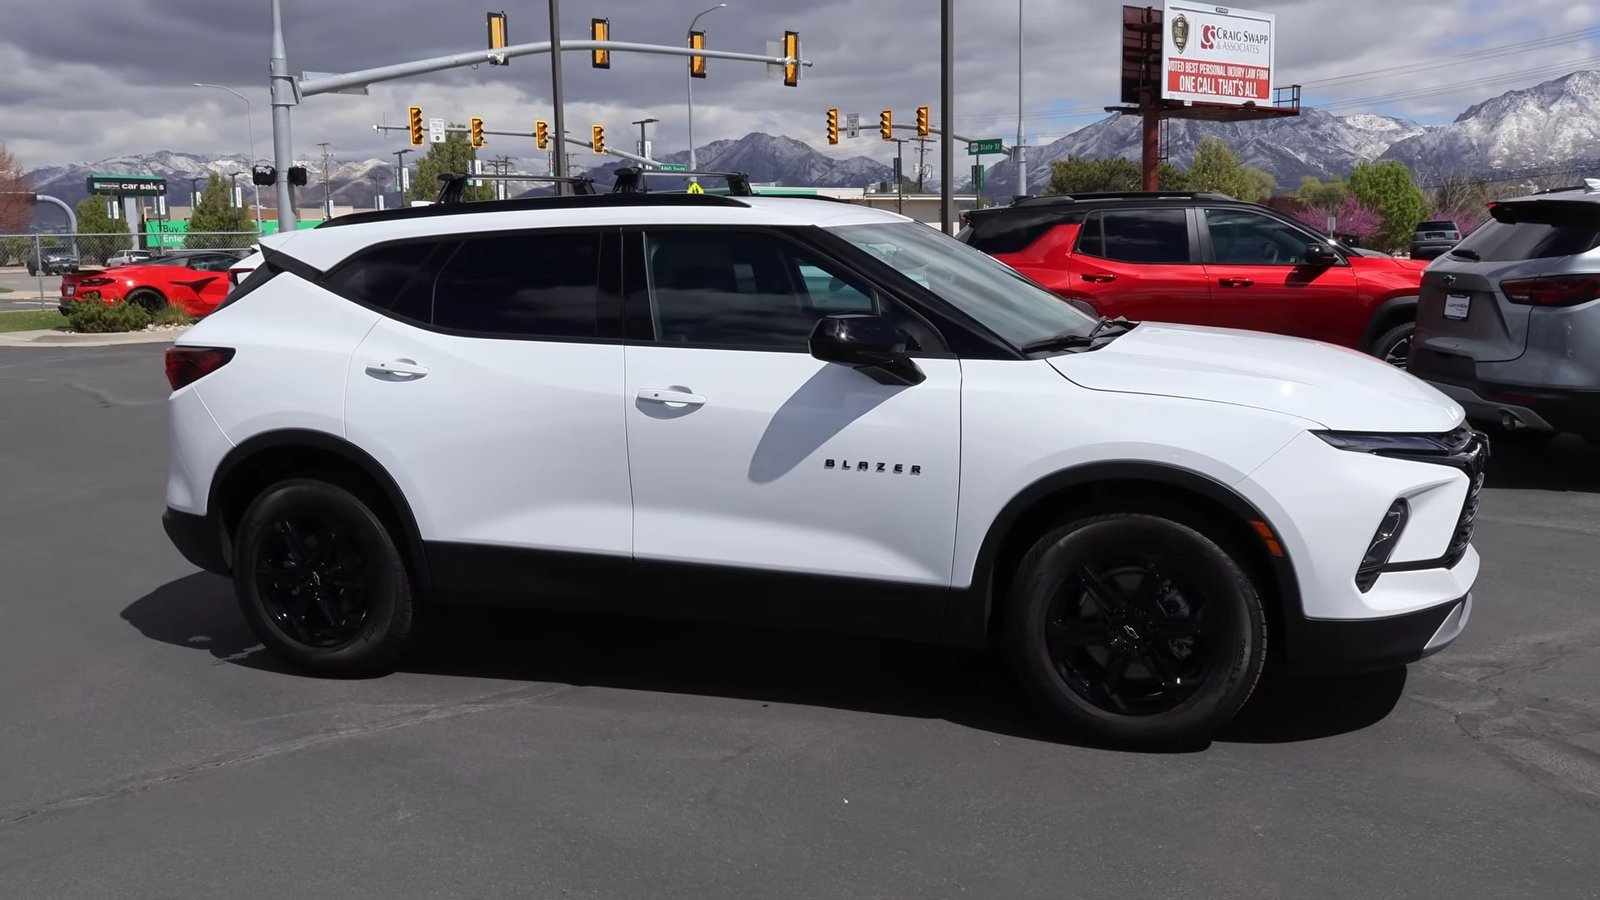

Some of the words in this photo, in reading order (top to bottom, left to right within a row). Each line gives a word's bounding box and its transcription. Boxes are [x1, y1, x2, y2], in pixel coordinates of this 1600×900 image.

[1216, 26, 1242, 42] CRAIG
[1243, 30, 1269, 45] SWAPP
[1222, 41, 1260, 54] ASSOCIATES
[1185, 62, 1199, 74] BEST
[1199, 63, 1227, 77] PERSONAL
[1245, 68, 1257, 80] LAW
[1179, 75, 1196, 92] ONE
[1197, 77, 1217, 94] CALL
[1217, 78, 1244, 96] THAT'S
[1244, 81, 1258, 97] ALL
[825, 458, 922, 475] BLAZER
